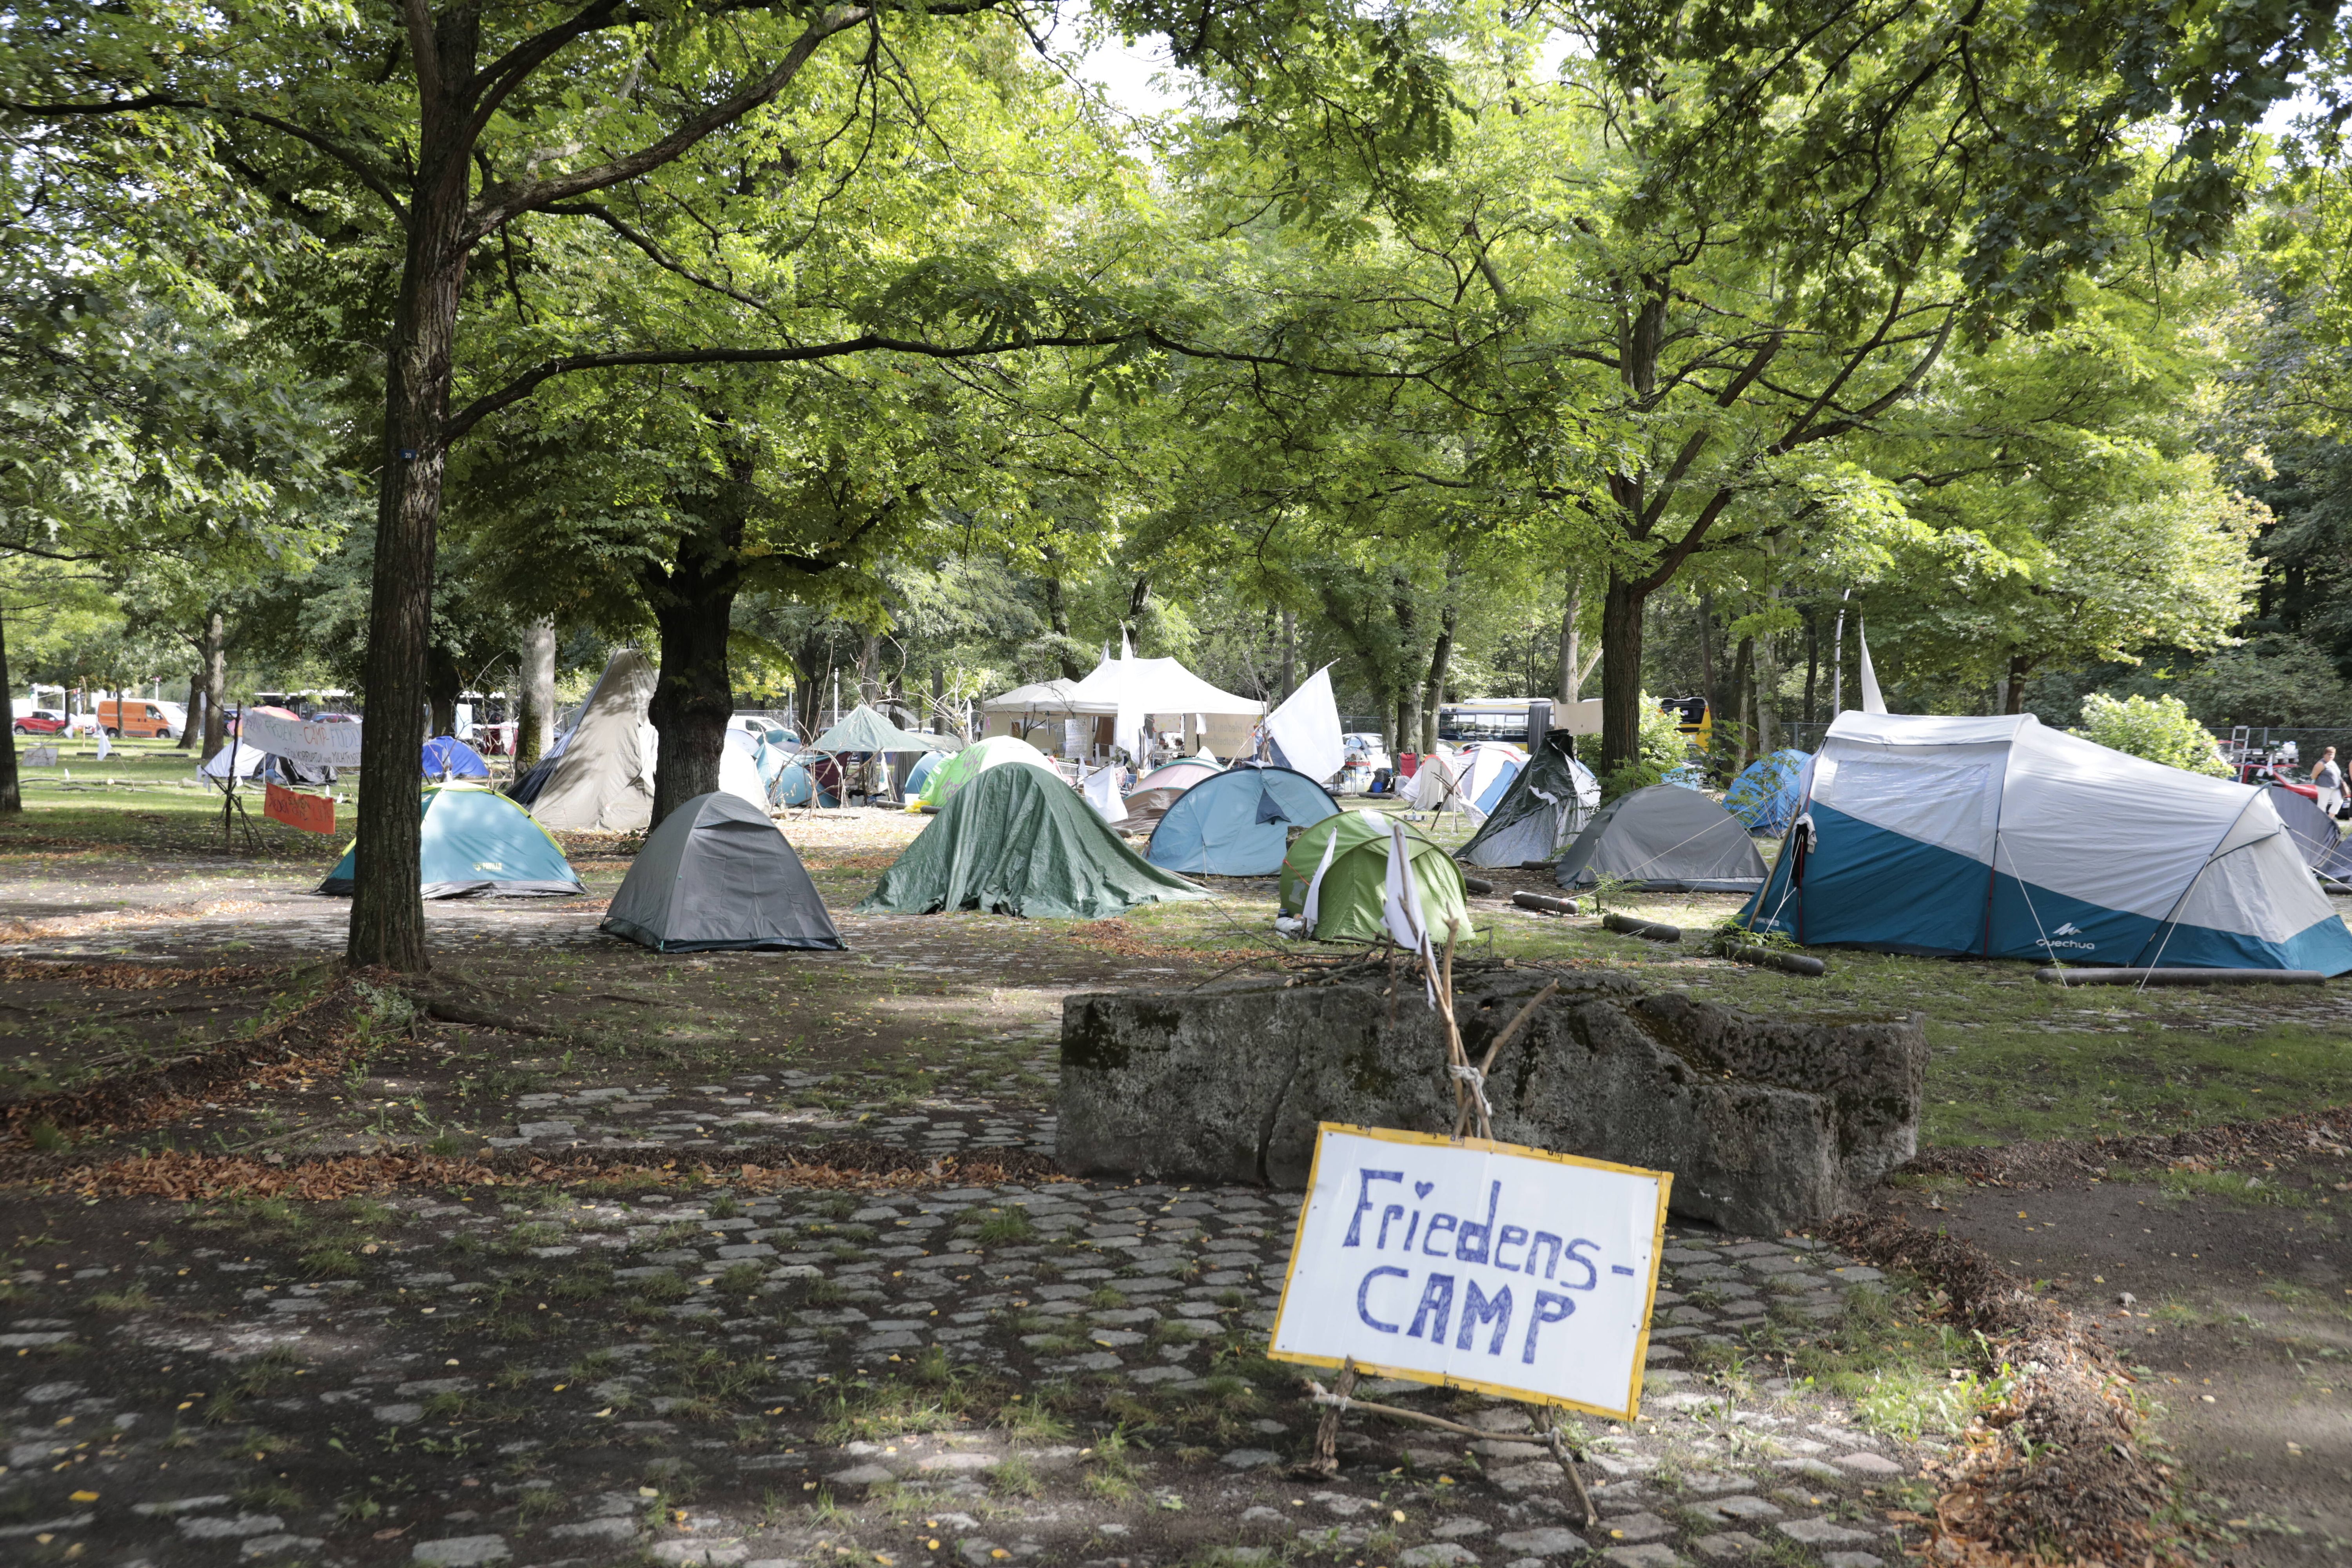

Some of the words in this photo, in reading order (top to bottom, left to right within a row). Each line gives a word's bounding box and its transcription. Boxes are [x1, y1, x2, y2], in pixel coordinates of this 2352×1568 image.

[2036, 939, 2095, 949] Quechua
[1342, 1167, 1634, 1291] Friedens-
[1357, 1265, 1576, 1364] CAMP
